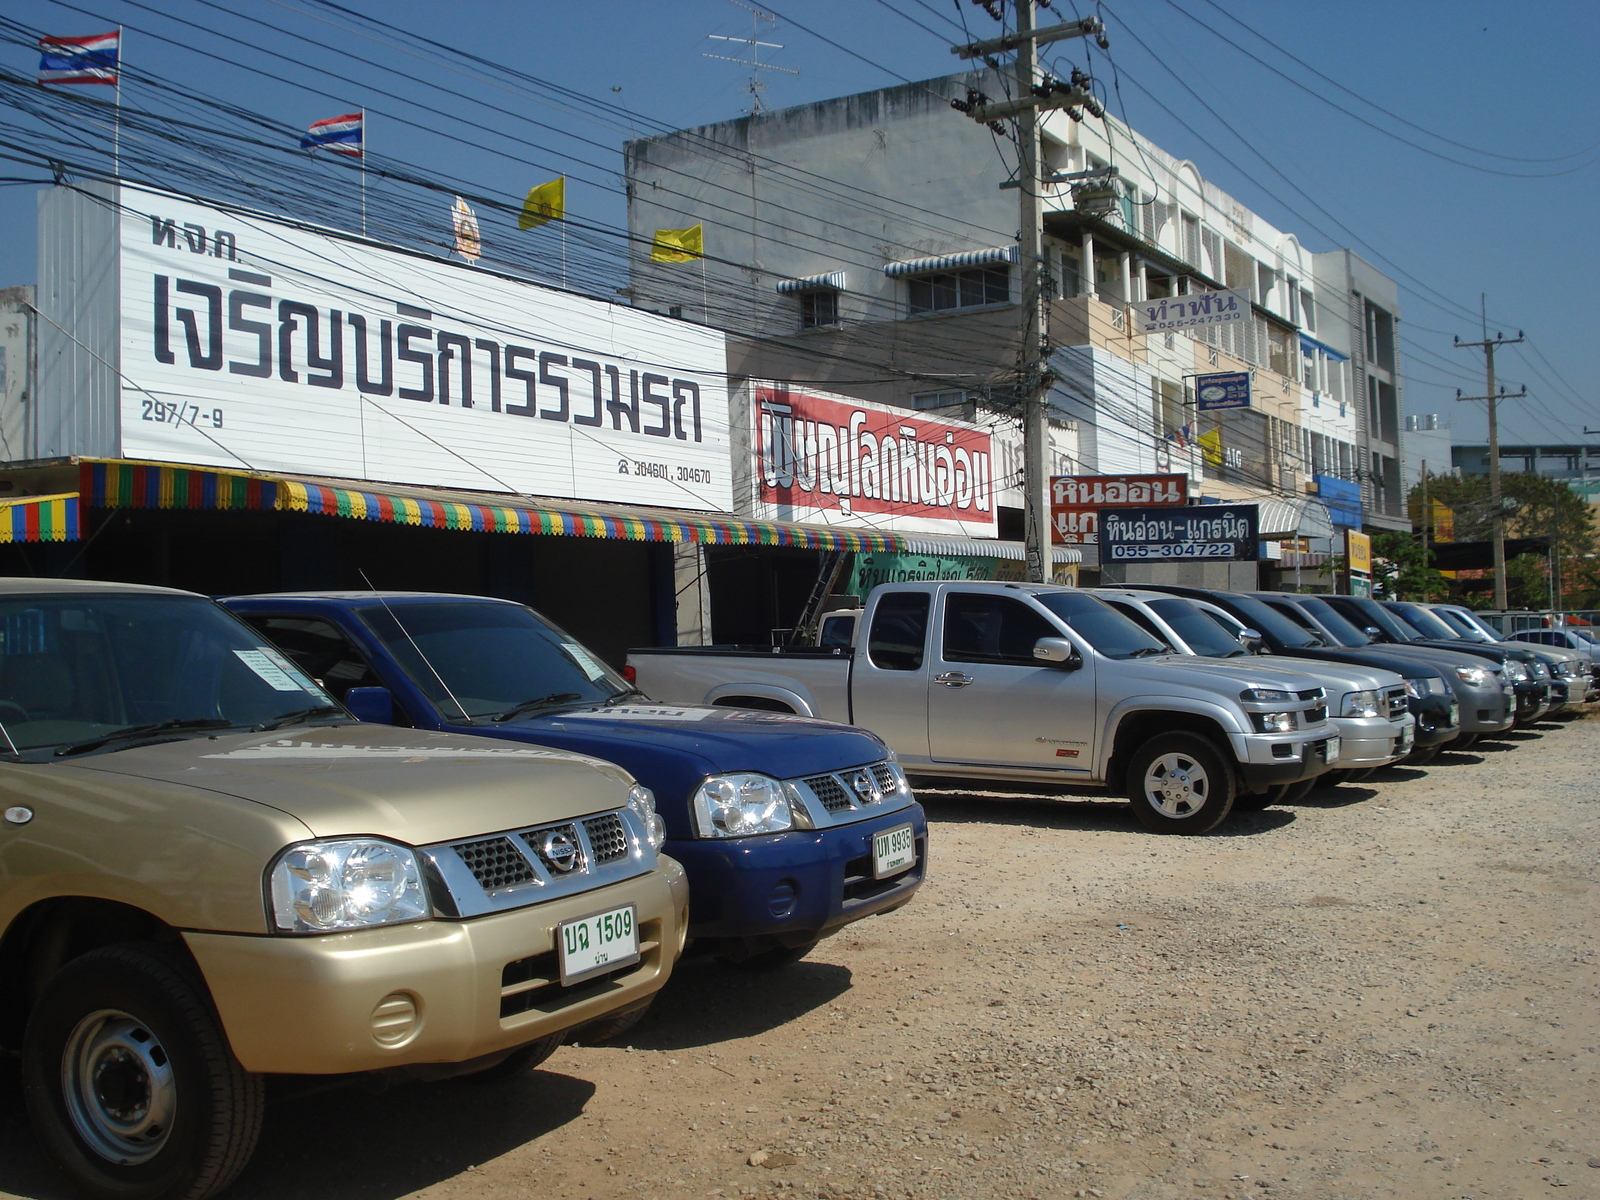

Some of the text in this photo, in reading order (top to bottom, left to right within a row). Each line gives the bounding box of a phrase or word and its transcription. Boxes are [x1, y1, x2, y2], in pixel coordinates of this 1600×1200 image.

[1147, 293, 1238, 321] ทำฟัน
[1159, 312, 1241, 329] 055-247330
[154, 267, 702, 442] เจริญบริการรวมรถ
[142, 400, 223, 429] 297/7-9
[1226, 447, 1242, 468] AIG
[677, 466, 711, 484] 304670
[1053, 477, 1181, 504] หินอ่อน
[1106, 512, 1249, 541] หินอ่อน-แกรนิต
[1115, 544, 1232, 557] 055-304722
[892, 829, 911, 853] 9935
[596, 910, 632, 945] 1509
